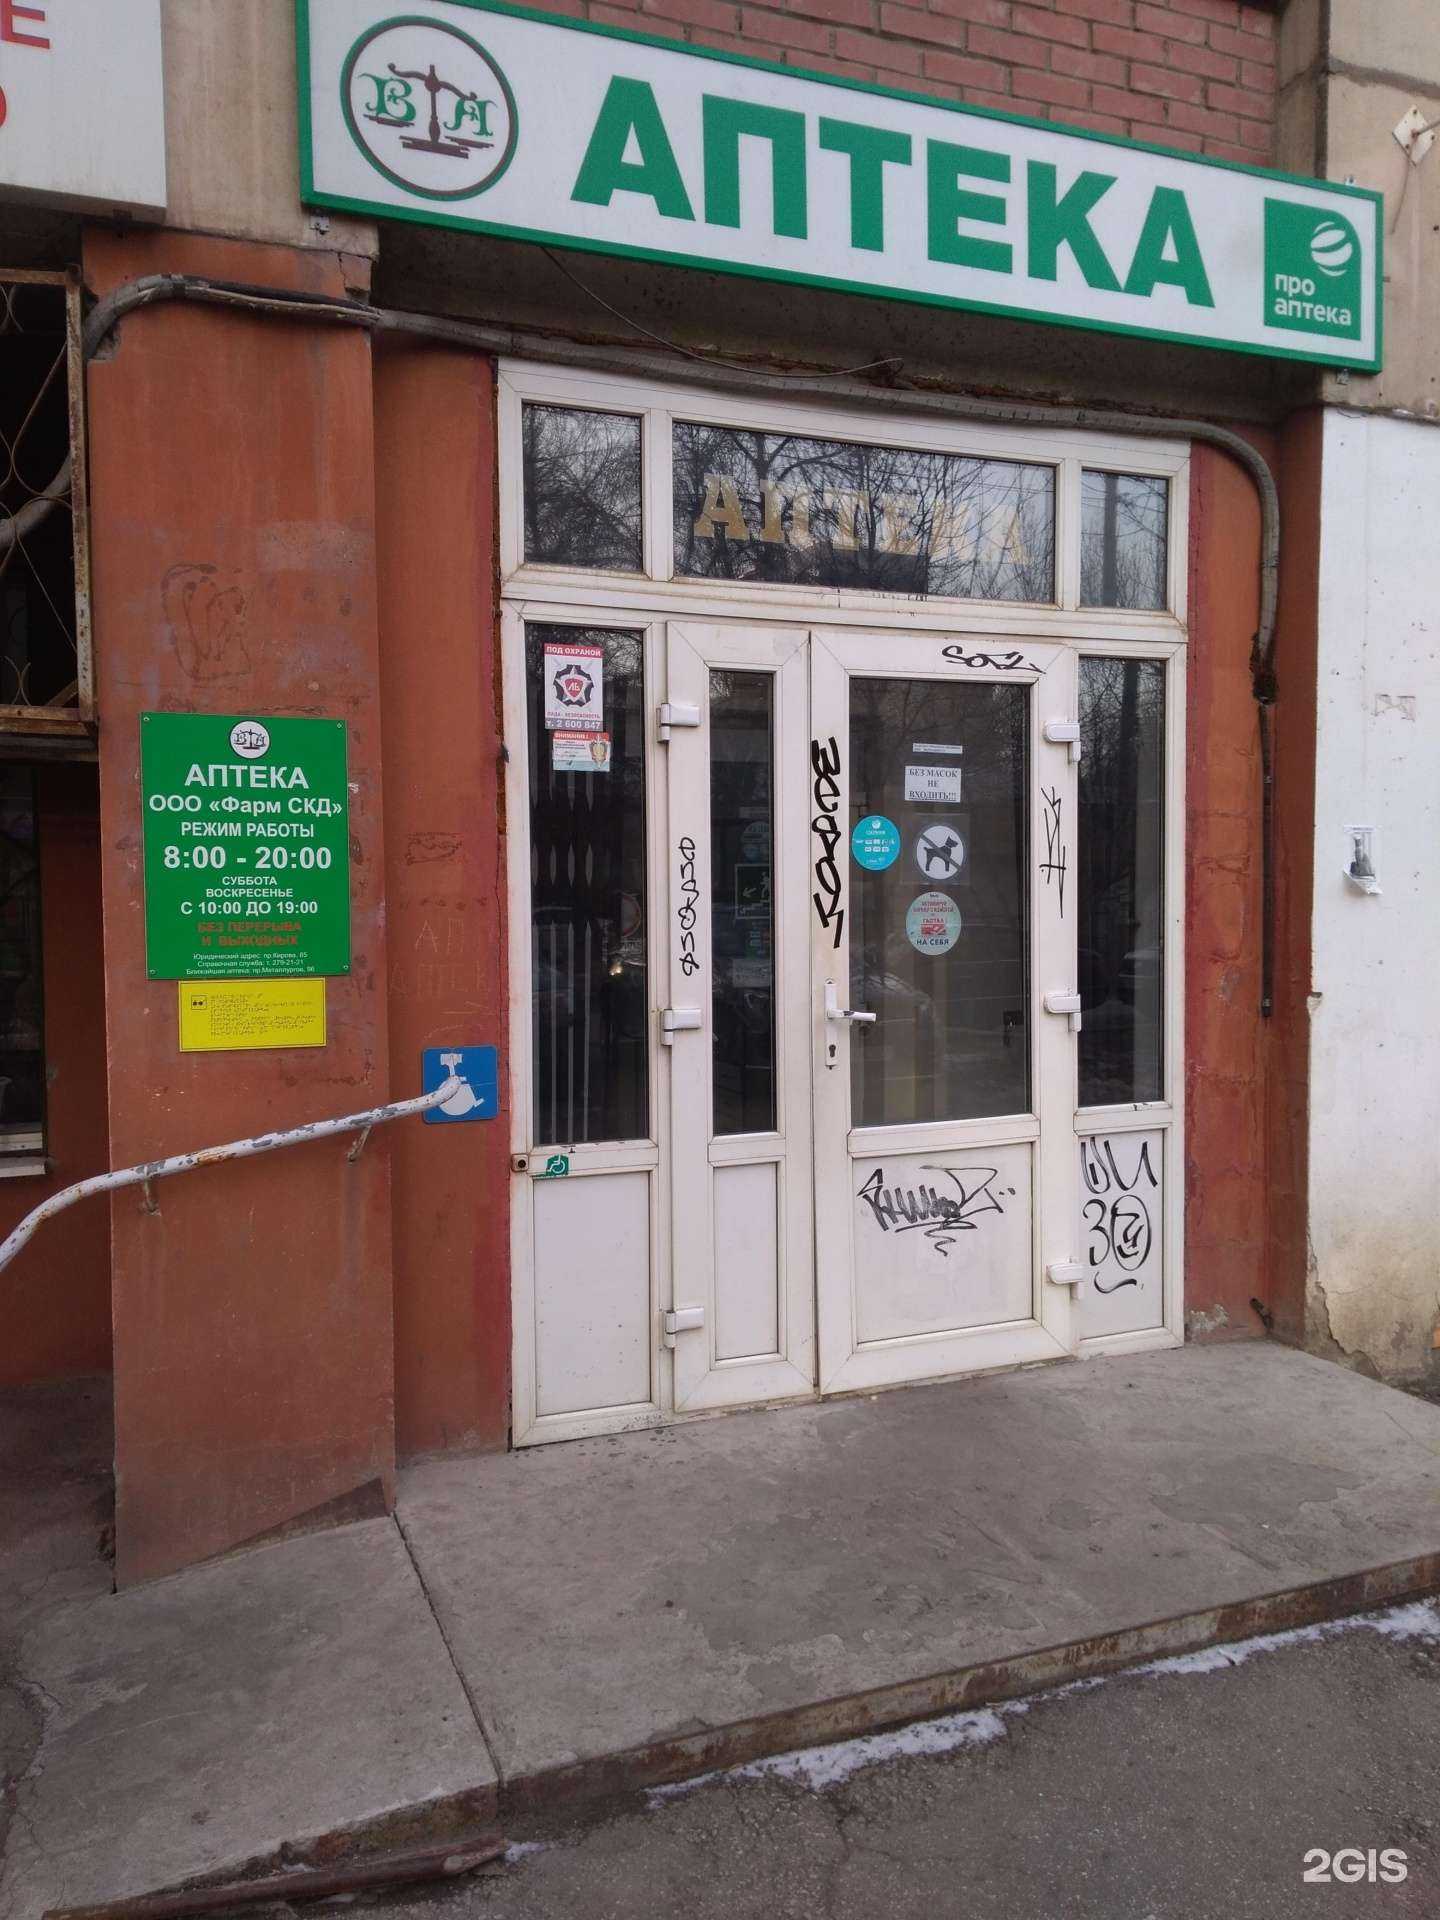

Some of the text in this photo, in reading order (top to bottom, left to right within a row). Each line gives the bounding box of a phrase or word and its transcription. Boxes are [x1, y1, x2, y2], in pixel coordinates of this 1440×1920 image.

[570, 74, 1216, 308] АПТЕКА
[1274, 273, 1316, 298] про
[1274, 298, 1352, 326] аптека
[546, 646, 601, 657] ПОД ОХРАНОЙ
[184, 763, 310, 790] АПТЕКА
[909, 768, 958, 778] БЕЗ МАСОК
[927, 779, 940, 788] НЕ
[149, 794, 343, 818] ООО «Фарм СКД»
[181, 821, 315, 838] РЕЖИМ РАБОТЫ
[163, 845, 227, 870] 8:00
[254, 846, 332, 870] 20:00
[221, 876, 279, 886] СУББОТА
[205, 888, 294, 898] ВОСКРЕСЕНЬЕ
[180, 900, 319, 917] С 10:00 ДО 19:00
[916, 938, 949, 946] НА СЕБЯ
